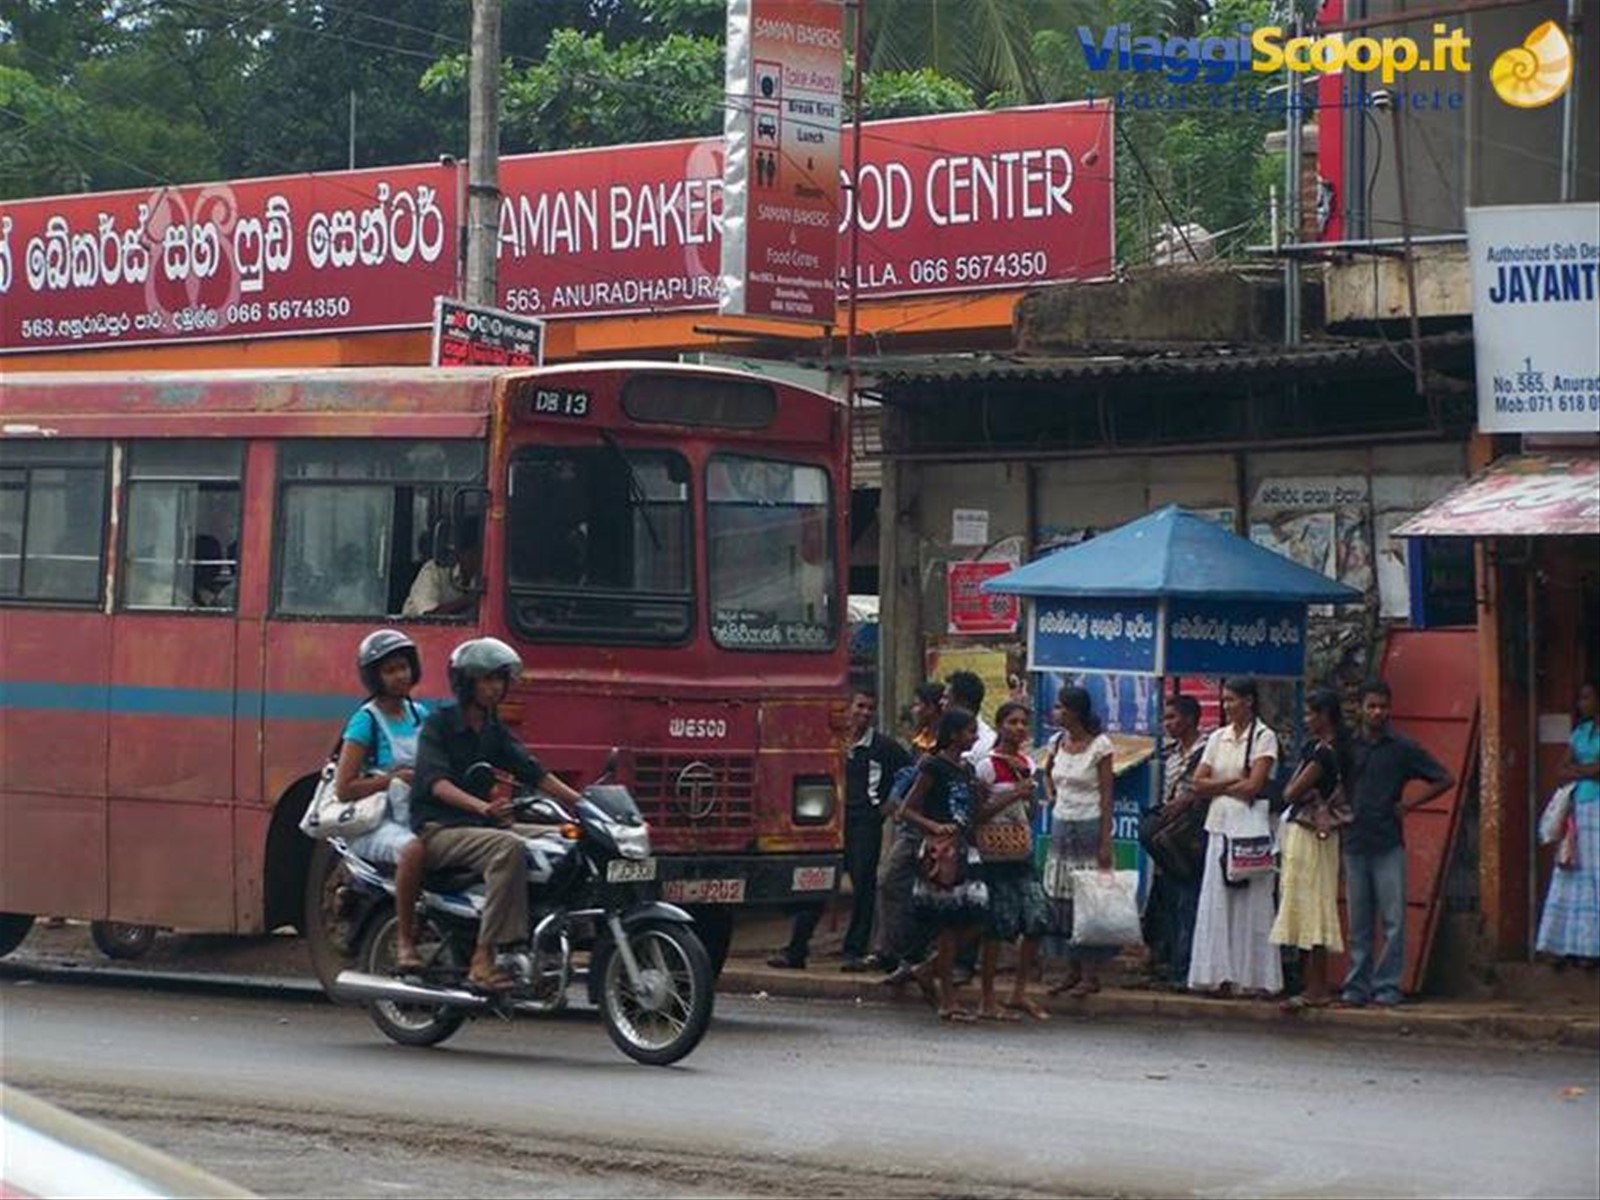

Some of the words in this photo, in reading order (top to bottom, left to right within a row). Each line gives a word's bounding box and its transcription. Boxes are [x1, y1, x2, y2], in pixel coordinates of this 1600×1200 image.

[497, 187, 598, 259] AMAN
[610, 178, 725, 251] BAKER
[838, 163, 913, 234] OD
[162, 218, 219, 281] සහ
[1487, 245, 1549, 263] Authorized
[1553, 243, 1577, 260] Sub
[909, 259, 948, 285] 066
[955, 251, 1047, 280] 5674350
[1489, 264, 1600, 304] JAYANT
[227, 303, 261, 323] 066
[267, 297, 350, 320] 5674350
[536, 390, 560, 412] DB
[565, 393, 588, 415] 13
[1558, 395, 1583, 412] 618
[1588, 395, 1600, 412] 0
